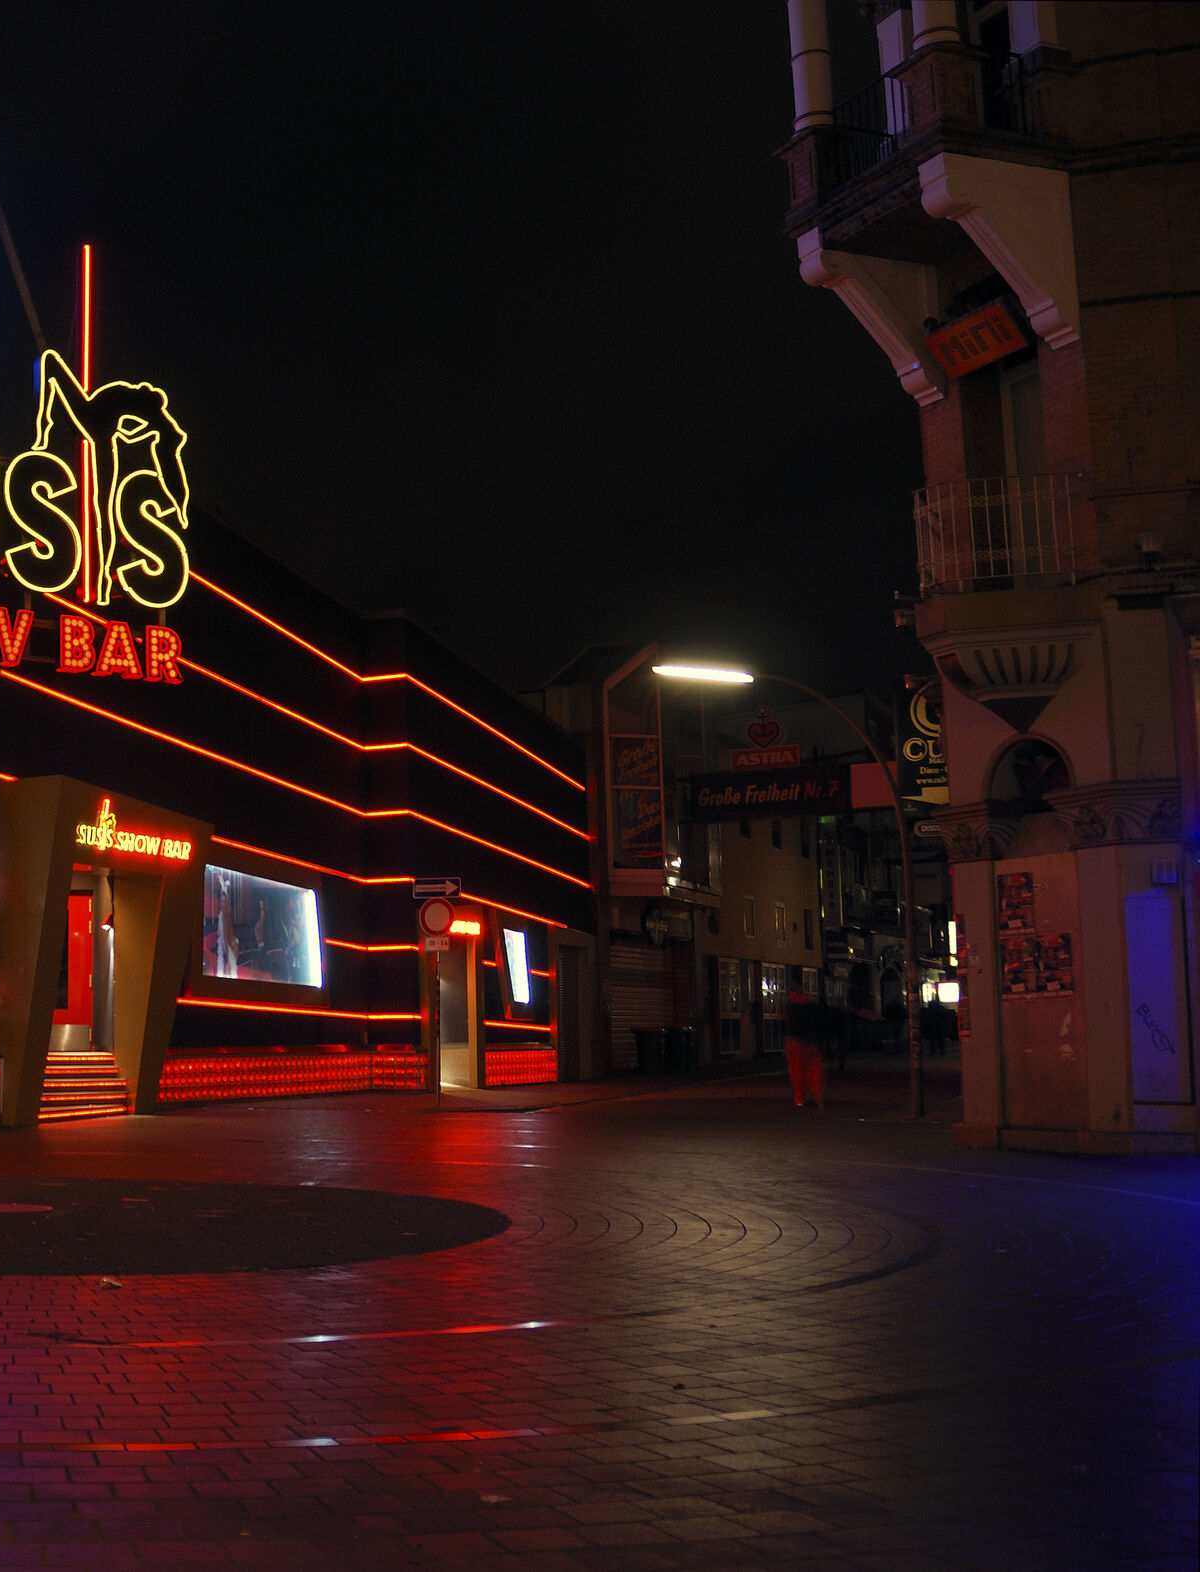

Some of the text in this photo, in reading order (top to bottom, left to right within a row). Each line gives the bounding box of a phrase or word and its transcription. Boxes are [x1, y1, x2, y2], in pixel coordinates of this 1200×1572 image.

[57, 614, 185, 685] BAR
[736, 751, 795, 767] ASTRA
[697, 786, 741, 808] Große
[745, 782, 801, 805] Freiheit
[114, 831, 161, 856] SHOW
[161, 839, 192, 861] BAR
